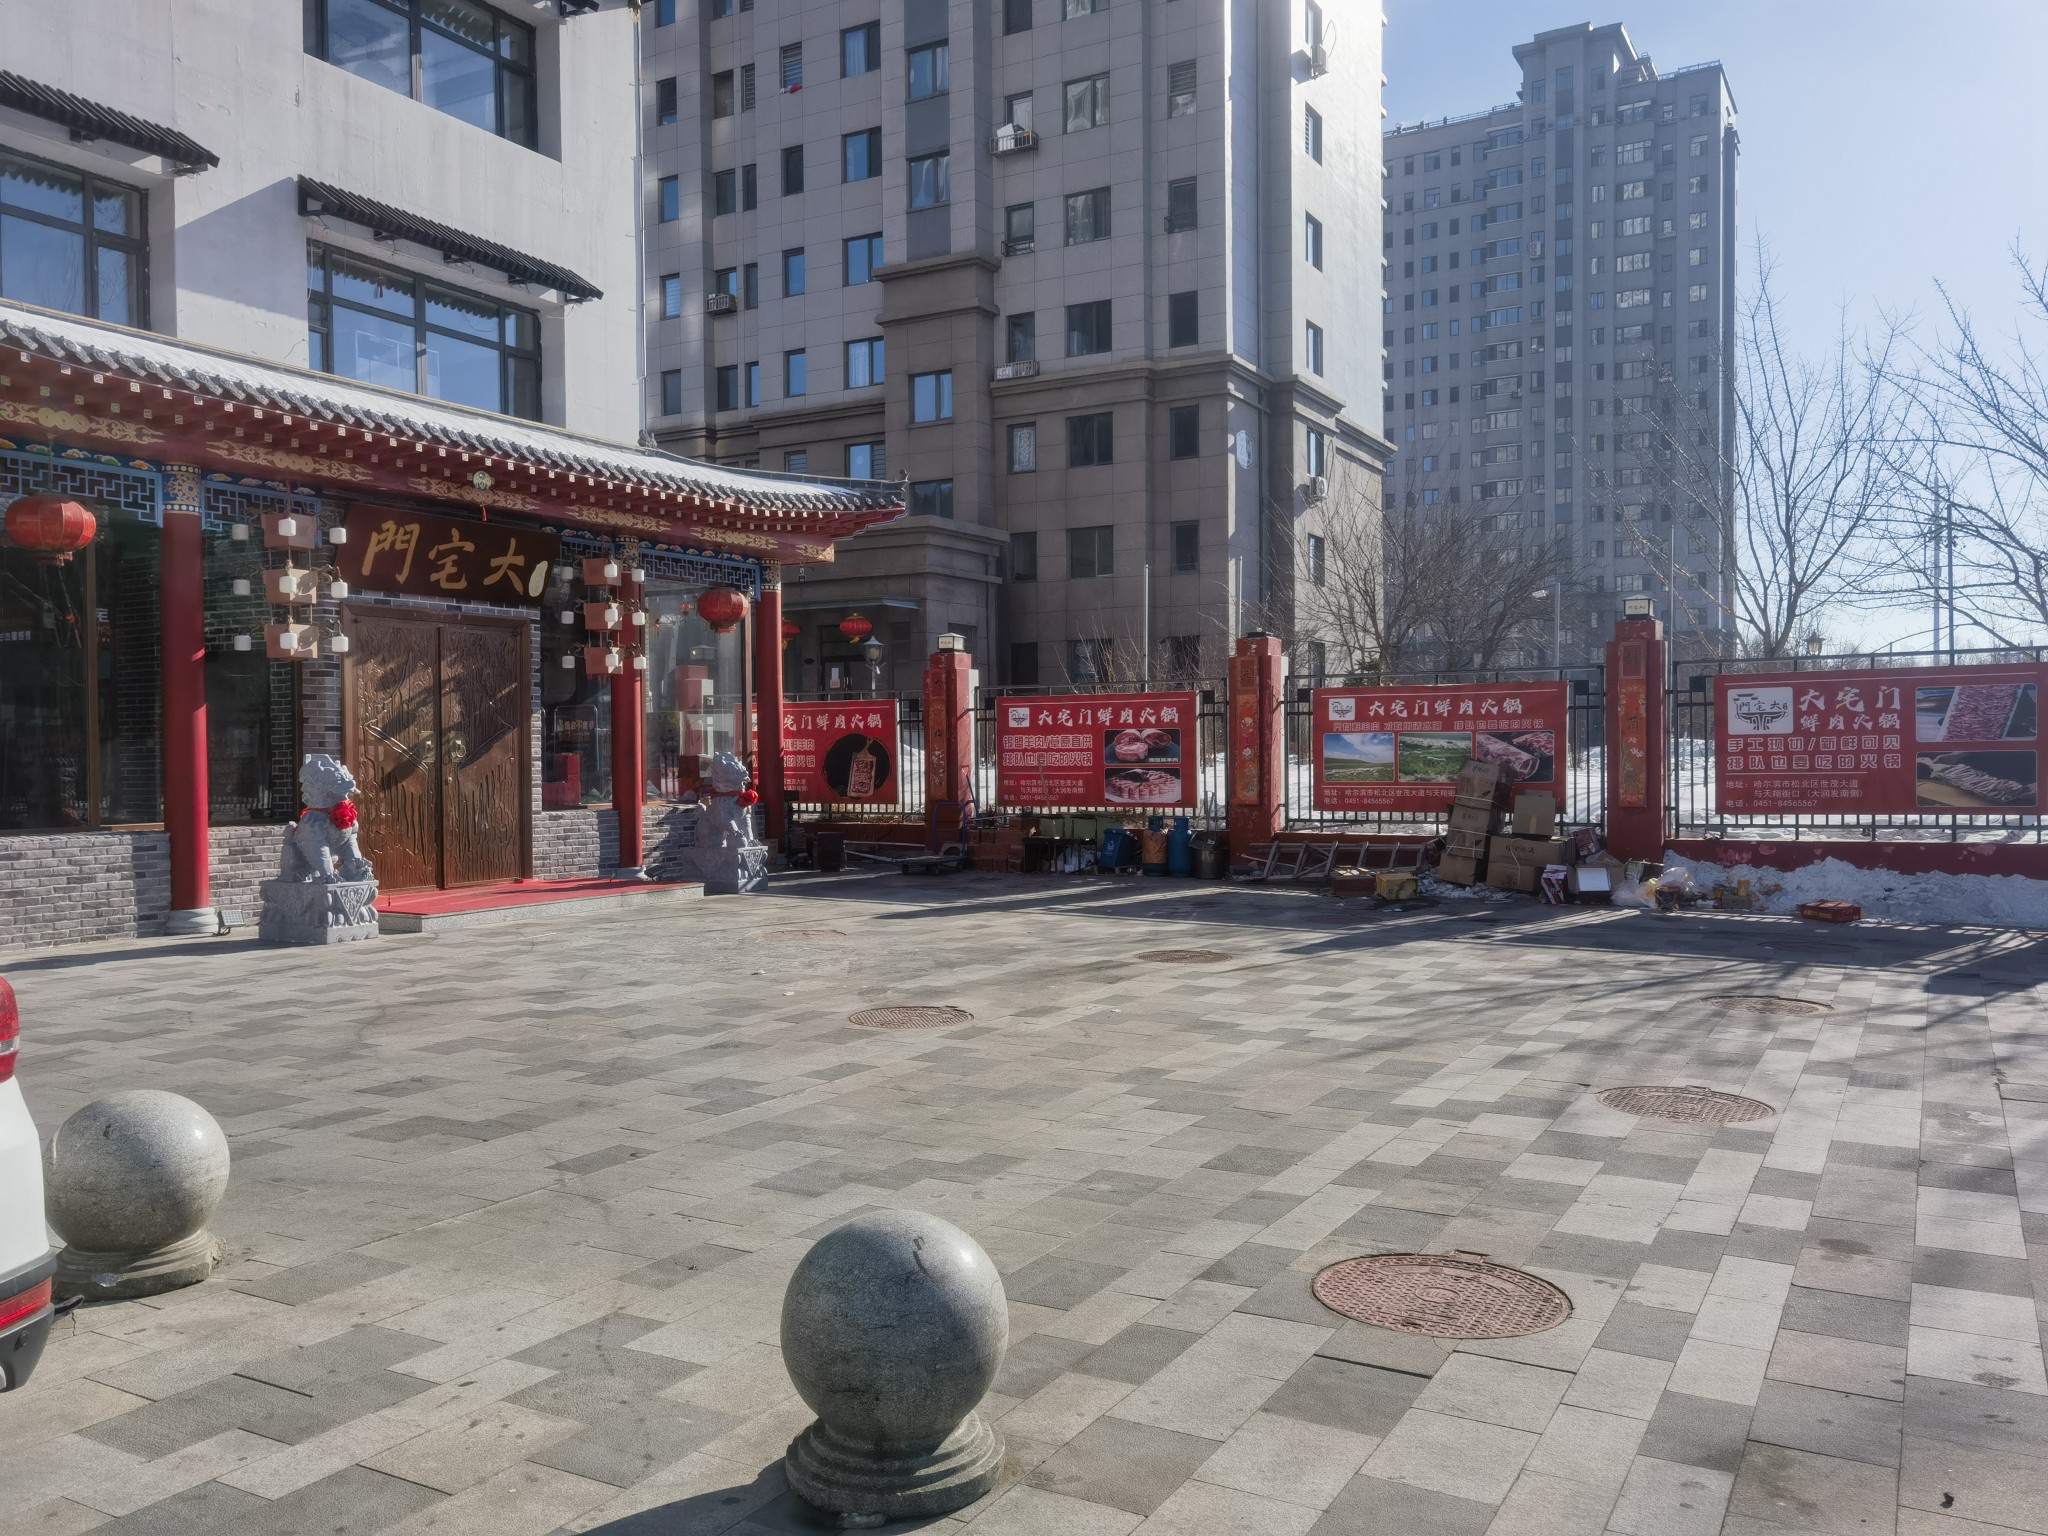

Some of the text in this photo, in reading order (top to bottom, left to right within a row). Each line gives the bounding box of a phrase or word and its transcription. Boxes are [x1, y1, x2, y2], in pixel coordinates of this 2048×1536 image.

[1368, 698, 1523, 717] 大宅门鲜肉火锅
[1797, 686, 1900, 712] 大宅门
[1037, 706, 1179, 727] 大宅门鲜肉火锅
[1454, 719, 1544, 730] 排队也要吃的火锅
[1800, 713, 1900, 732] 鲜肉火锅
[1727, 735, 1901, 752] 手工现切/新鲜可见
[1003, 752, 1093, 767] 排队也要吃的火锅
[1727, 754, 1901, 770] 排队也要吃的火锅
